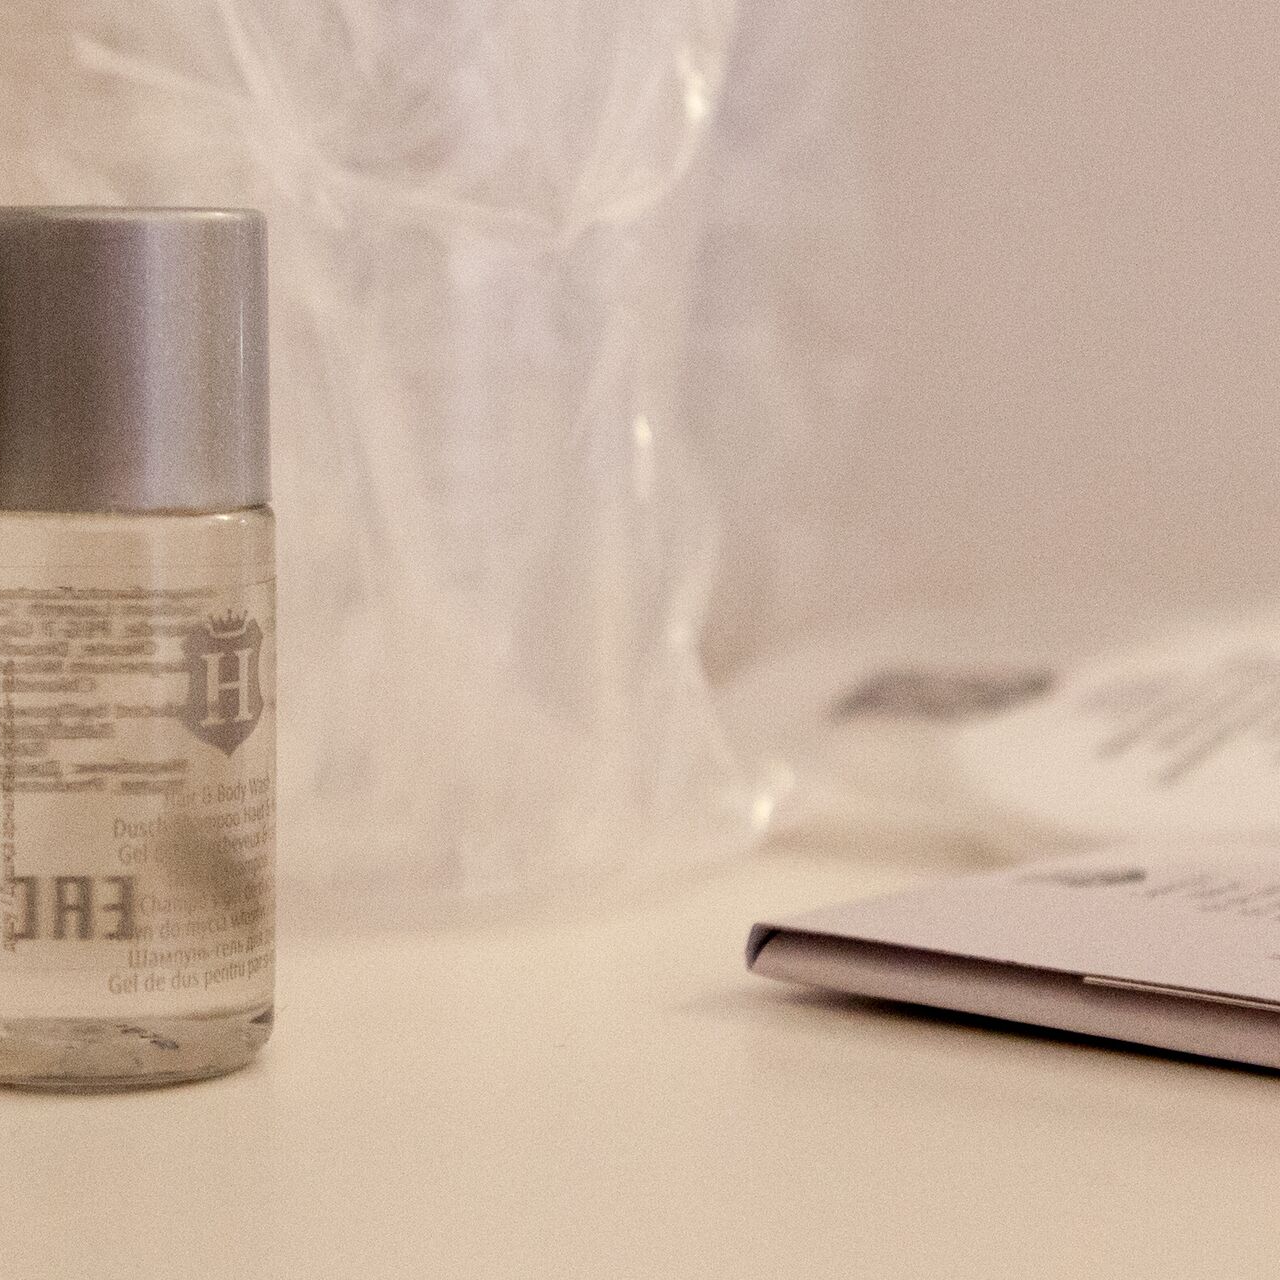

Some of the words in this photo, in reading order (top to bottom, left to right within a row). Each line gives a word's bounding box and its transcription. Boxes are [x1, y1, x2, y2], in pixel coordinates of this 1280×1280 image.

[107, 972, 138, 995] Gel
[144, 971, 166, 992] de
[204, 957, 246, 989] pentru
